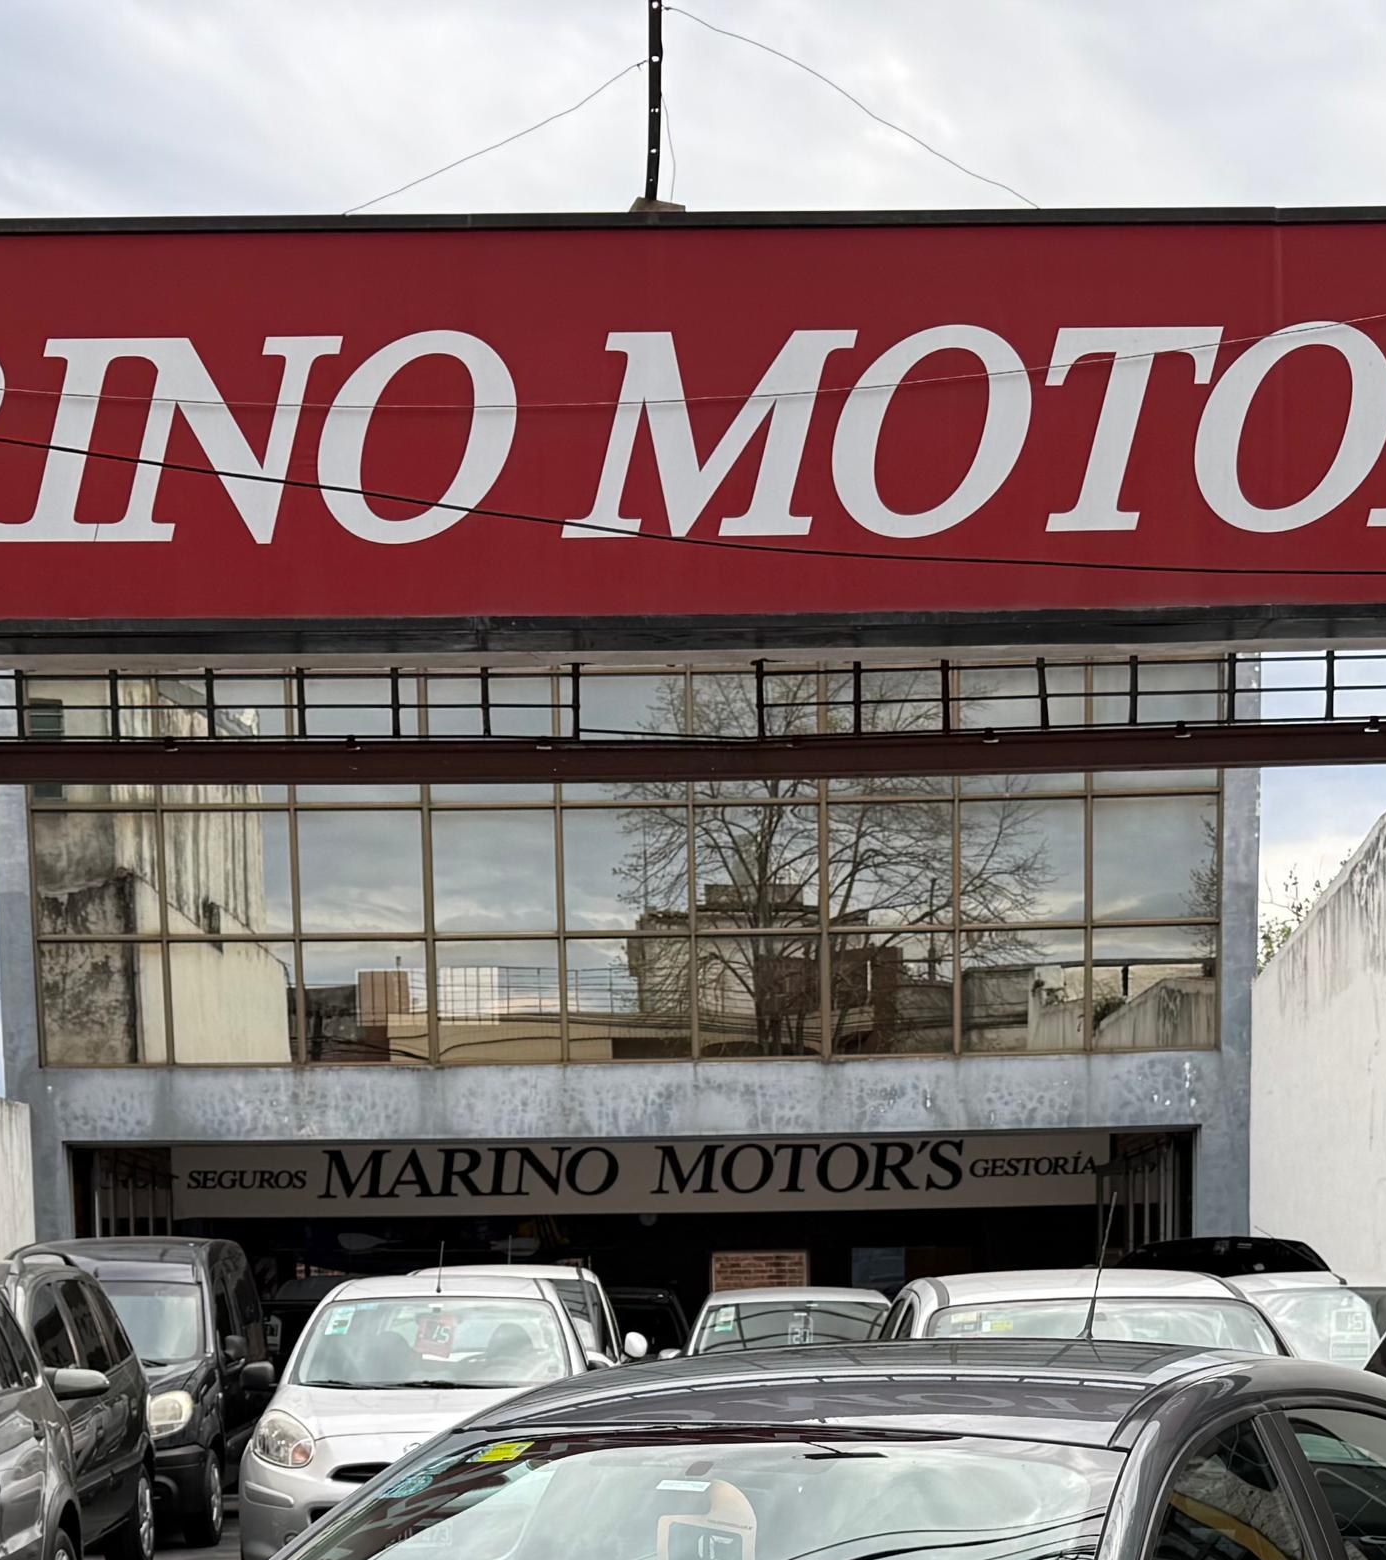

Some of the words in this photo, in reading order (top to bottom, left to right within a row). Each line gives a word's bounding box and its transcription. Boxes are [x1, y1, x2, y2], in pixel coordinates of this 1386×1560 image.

[186, 1168, 308, 1190] SEGUROS
[317, 1145, 620, 1199] MARINO
[649, 1139, 965, 1195] MOTOR'S
[968, 1151, 1097, 1178] GESTORÍA
